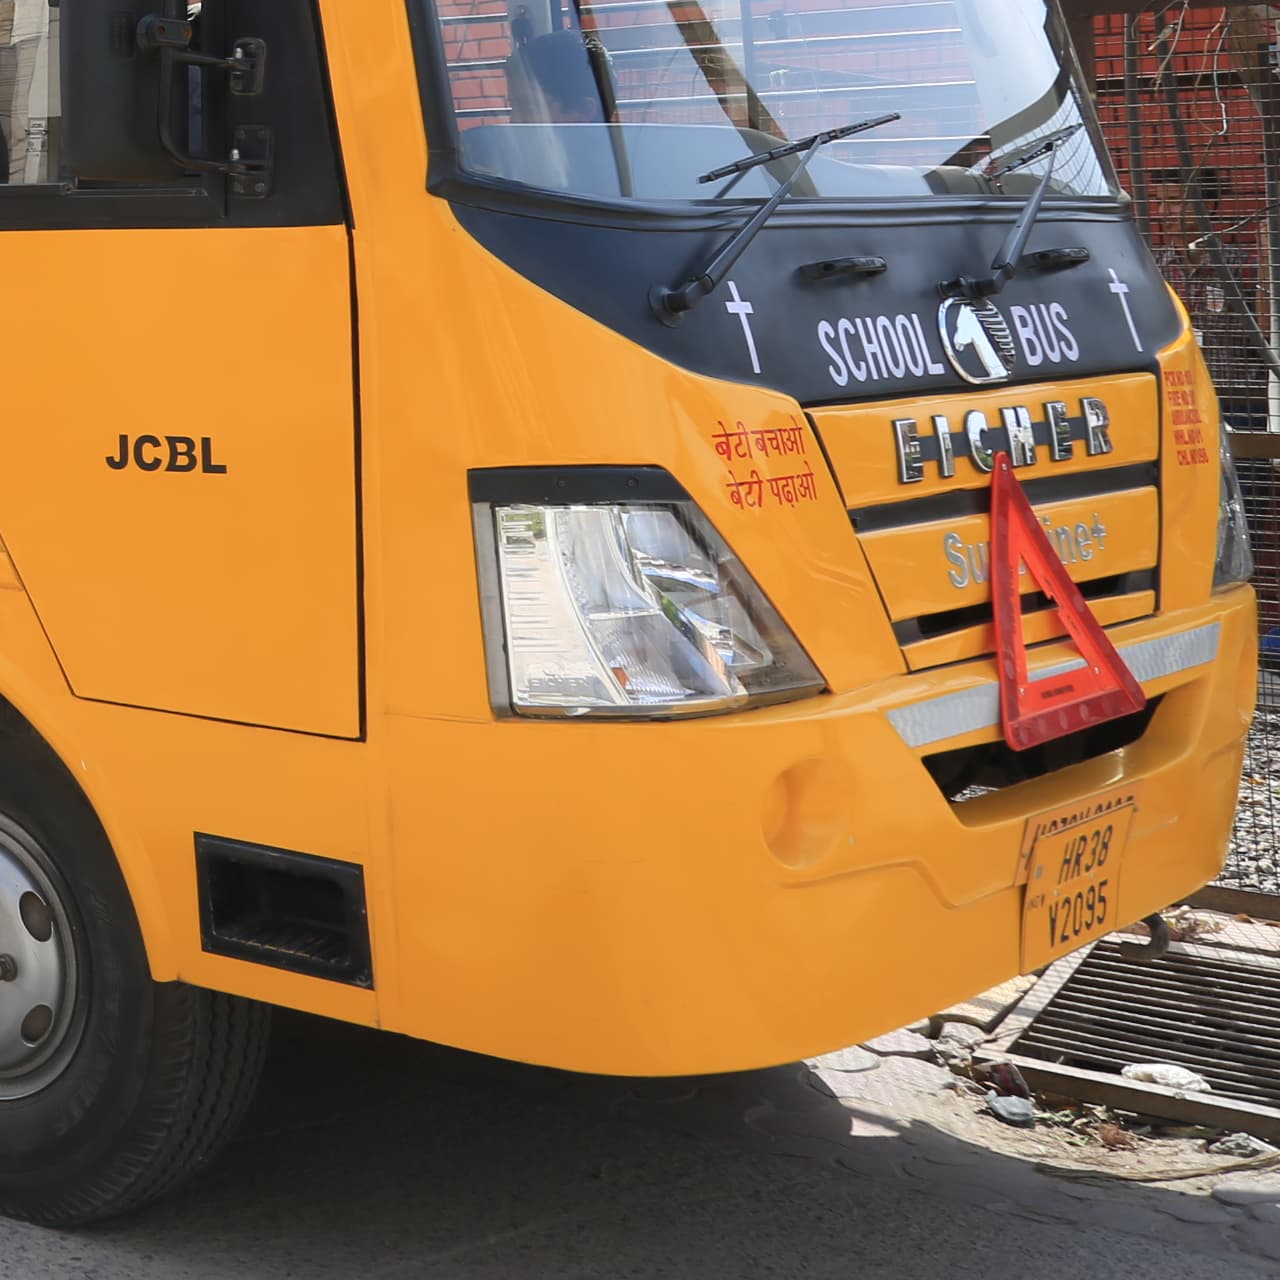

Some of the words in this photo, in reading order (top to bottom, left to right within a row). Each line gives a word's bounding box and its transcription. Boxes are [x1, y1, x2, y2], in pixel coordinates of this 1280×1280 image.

[817, 313, 945, 387] SCHOOL
[1010, 301, 1080, 367] BUS
[105, 434, 228, 474] JCBL
[712, 420, 752, 461] बेटी
[751, 415, 805, 458] बचाओ
[892, 397, 1113, 484] EICHER
[726, 469, 763, 510] बेटी
[766, 460, 818, 508] पढ़ाओ
[1057, 824, 1113, 885] HR38
